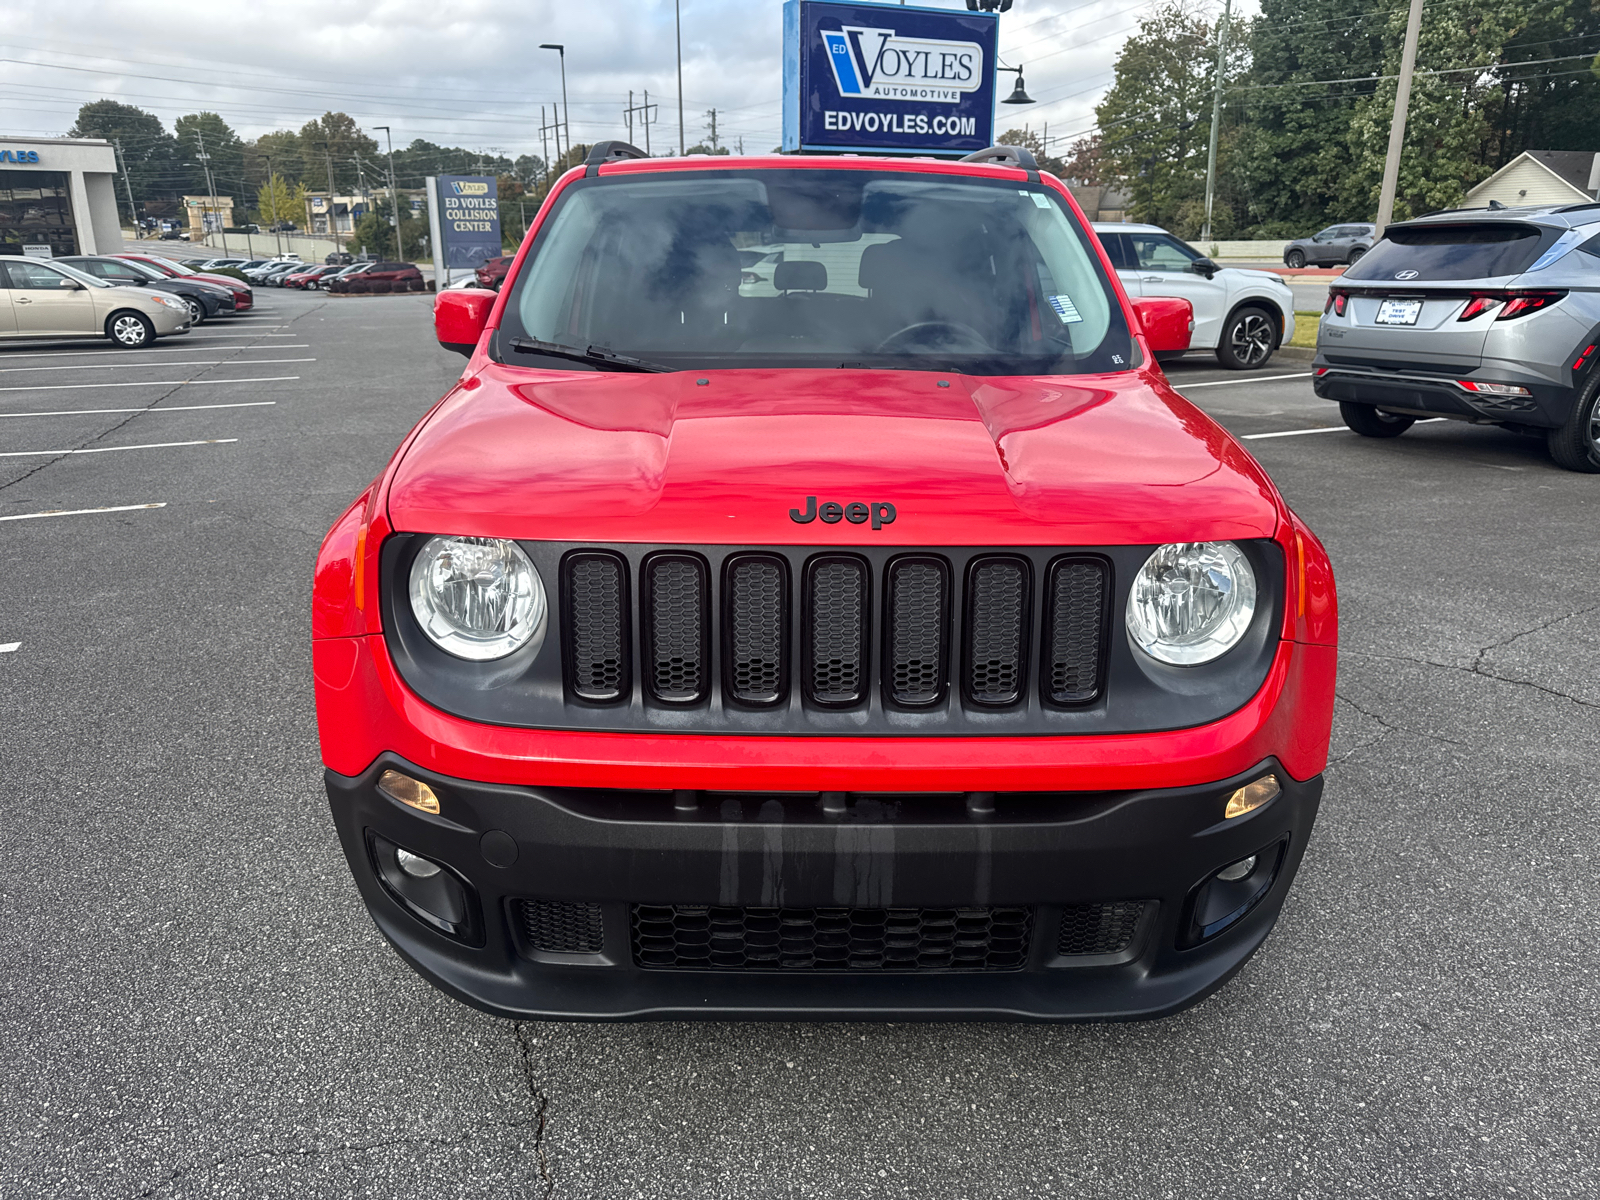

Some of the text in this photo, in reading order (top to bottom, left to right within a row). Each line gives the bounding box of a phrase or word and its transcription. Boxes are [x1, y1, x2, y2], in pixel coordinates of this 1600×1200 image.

[832, 43, 847, 54] ED
[847, 31, 973, 88] VOYLES
[874, 87, 958, 100] AUTOMOTIVE
[824, 111, 976, 136] EDVOYLES.COM
[445, 198, 497, 209] ED VOYLES
[446, 210, 497, 220] COLLISION
[454, 221, 492, 232] CENTER
[789, 496, 897, 530] Jeep
